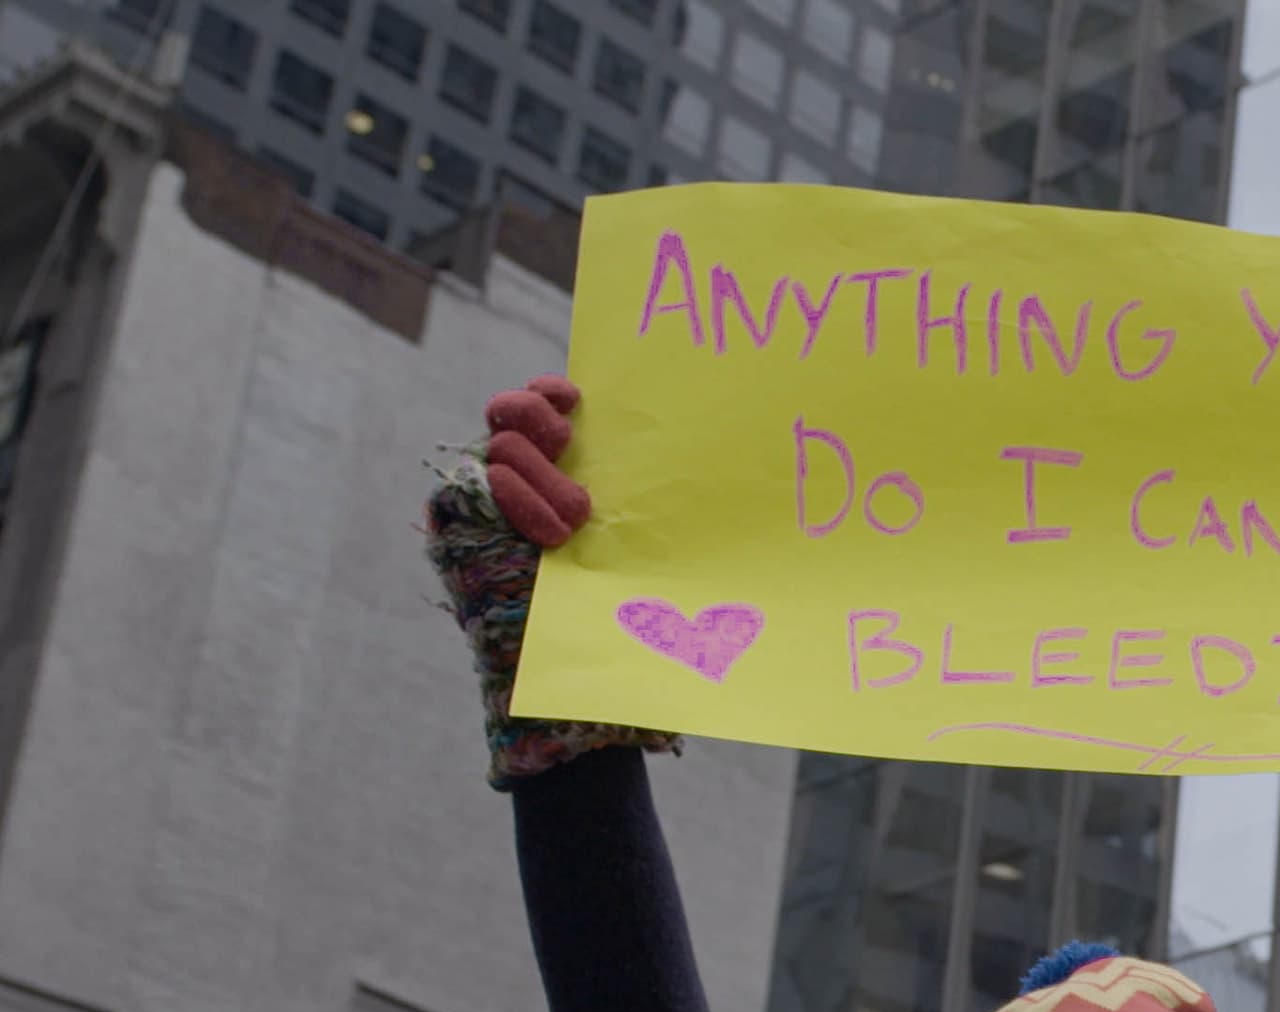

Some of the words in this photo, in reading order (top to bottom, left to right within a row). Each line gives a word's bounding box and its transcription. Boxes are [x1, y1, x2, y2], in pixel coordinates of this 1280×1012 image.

[637, 229, 1177, 382] ANYTHING
[792, 416, 925, 540] Do
[1000, 445, 1083, 546] I
